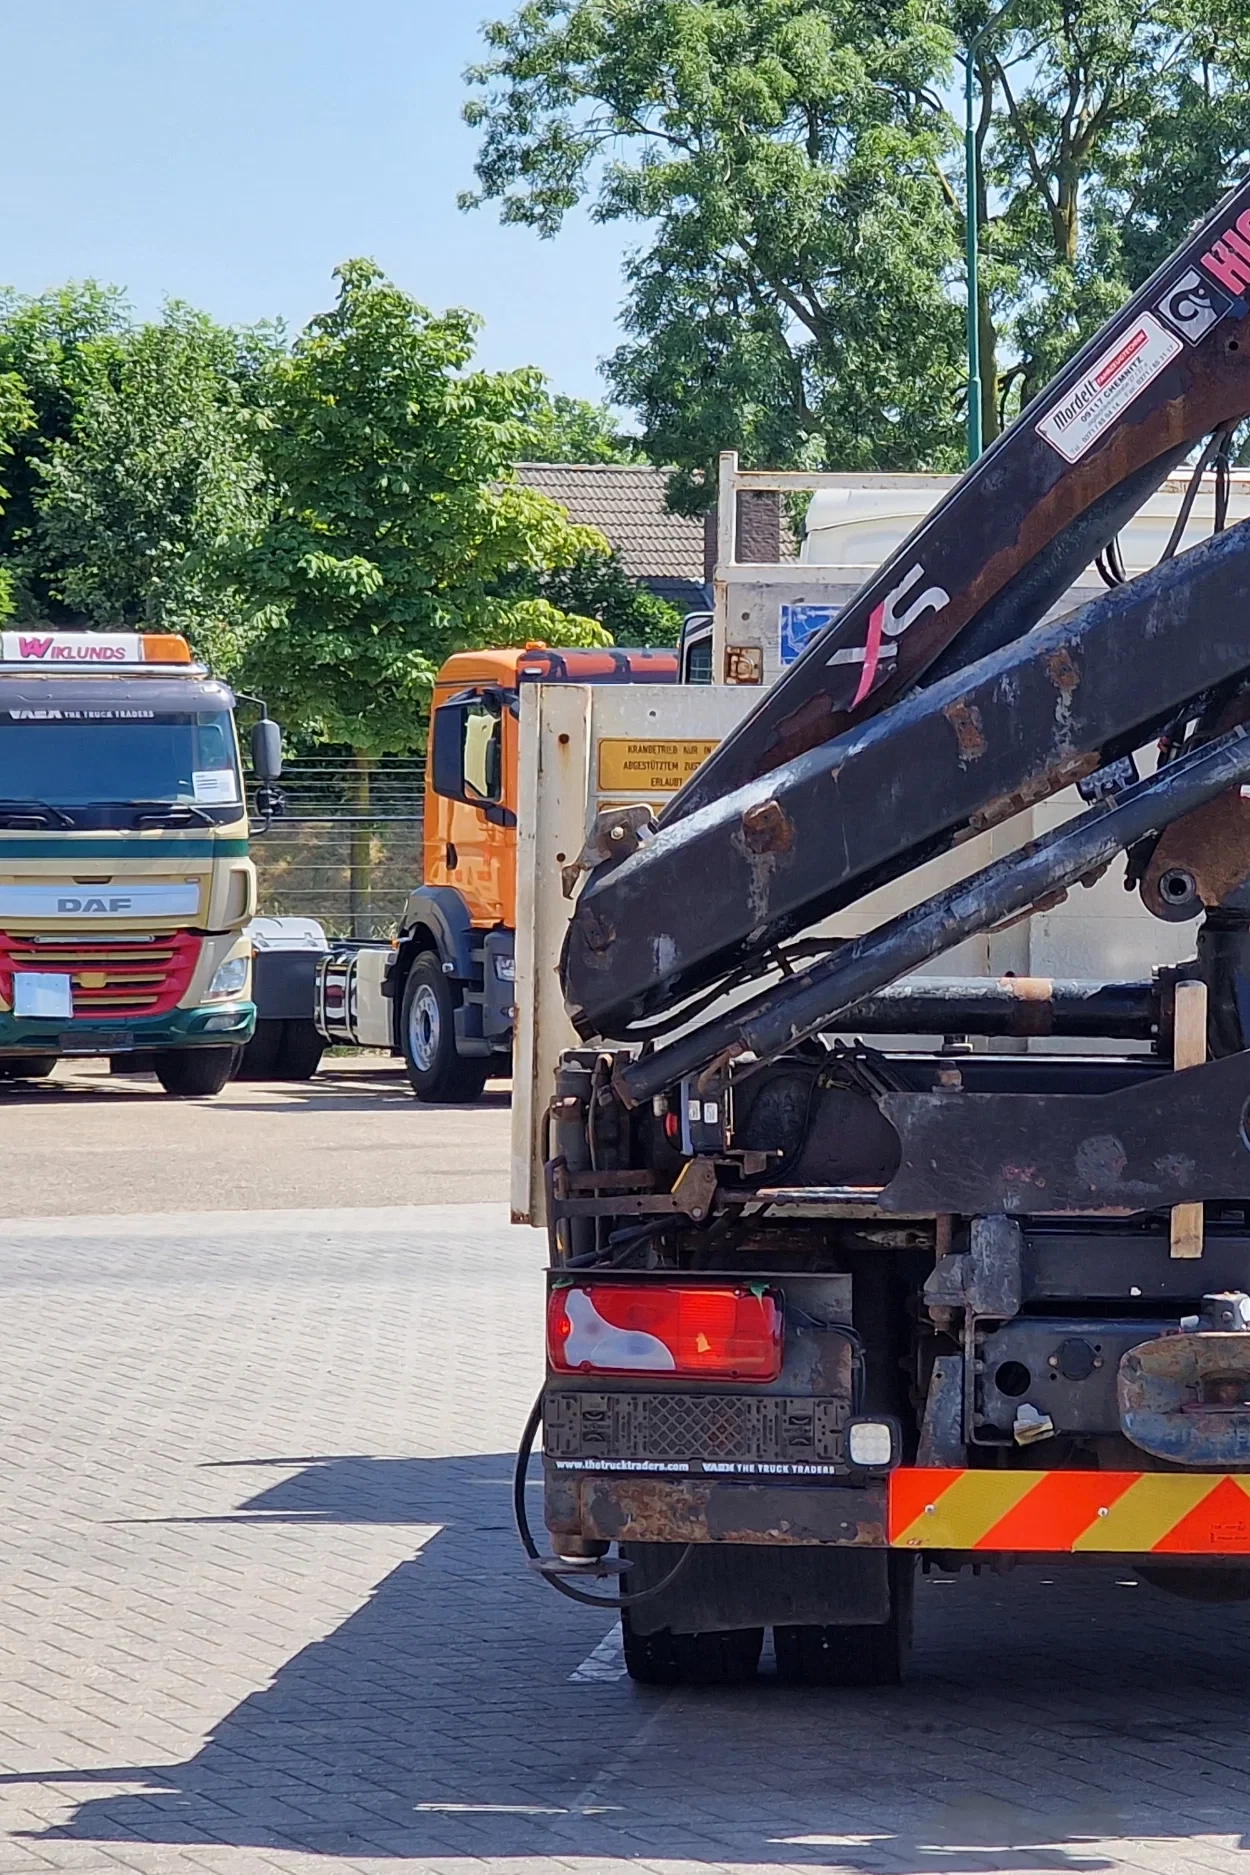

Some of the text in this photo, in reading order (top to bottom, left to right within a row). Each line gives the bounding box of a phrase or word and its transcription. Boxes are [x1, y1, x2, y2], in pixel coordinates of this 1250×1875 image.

[1078, 355, 1144, 423] 09117 CHEMNITZ
[64, 710, 82, 719] THE
[84, 710, 114, 719] TRUCK
[115, 710, 155, 718] TRADERS
[627, 744, 678, 755] KRANBETRIEB
[683, 745, 698, 755] NUR
[622, 758, 679, 771] ABGESTÜTZTEM
[650, 777, 683, 787] ERLAUBT
[57, 898, 132, 913] DAF
[555, 1459, 690, 1472] www.thetrucktraders.com
[736, 1463, 756, 1474] THE
[757, 1463, 790, 1475] TRUCK
[791, 1464, 836, 1475] TRADERS
